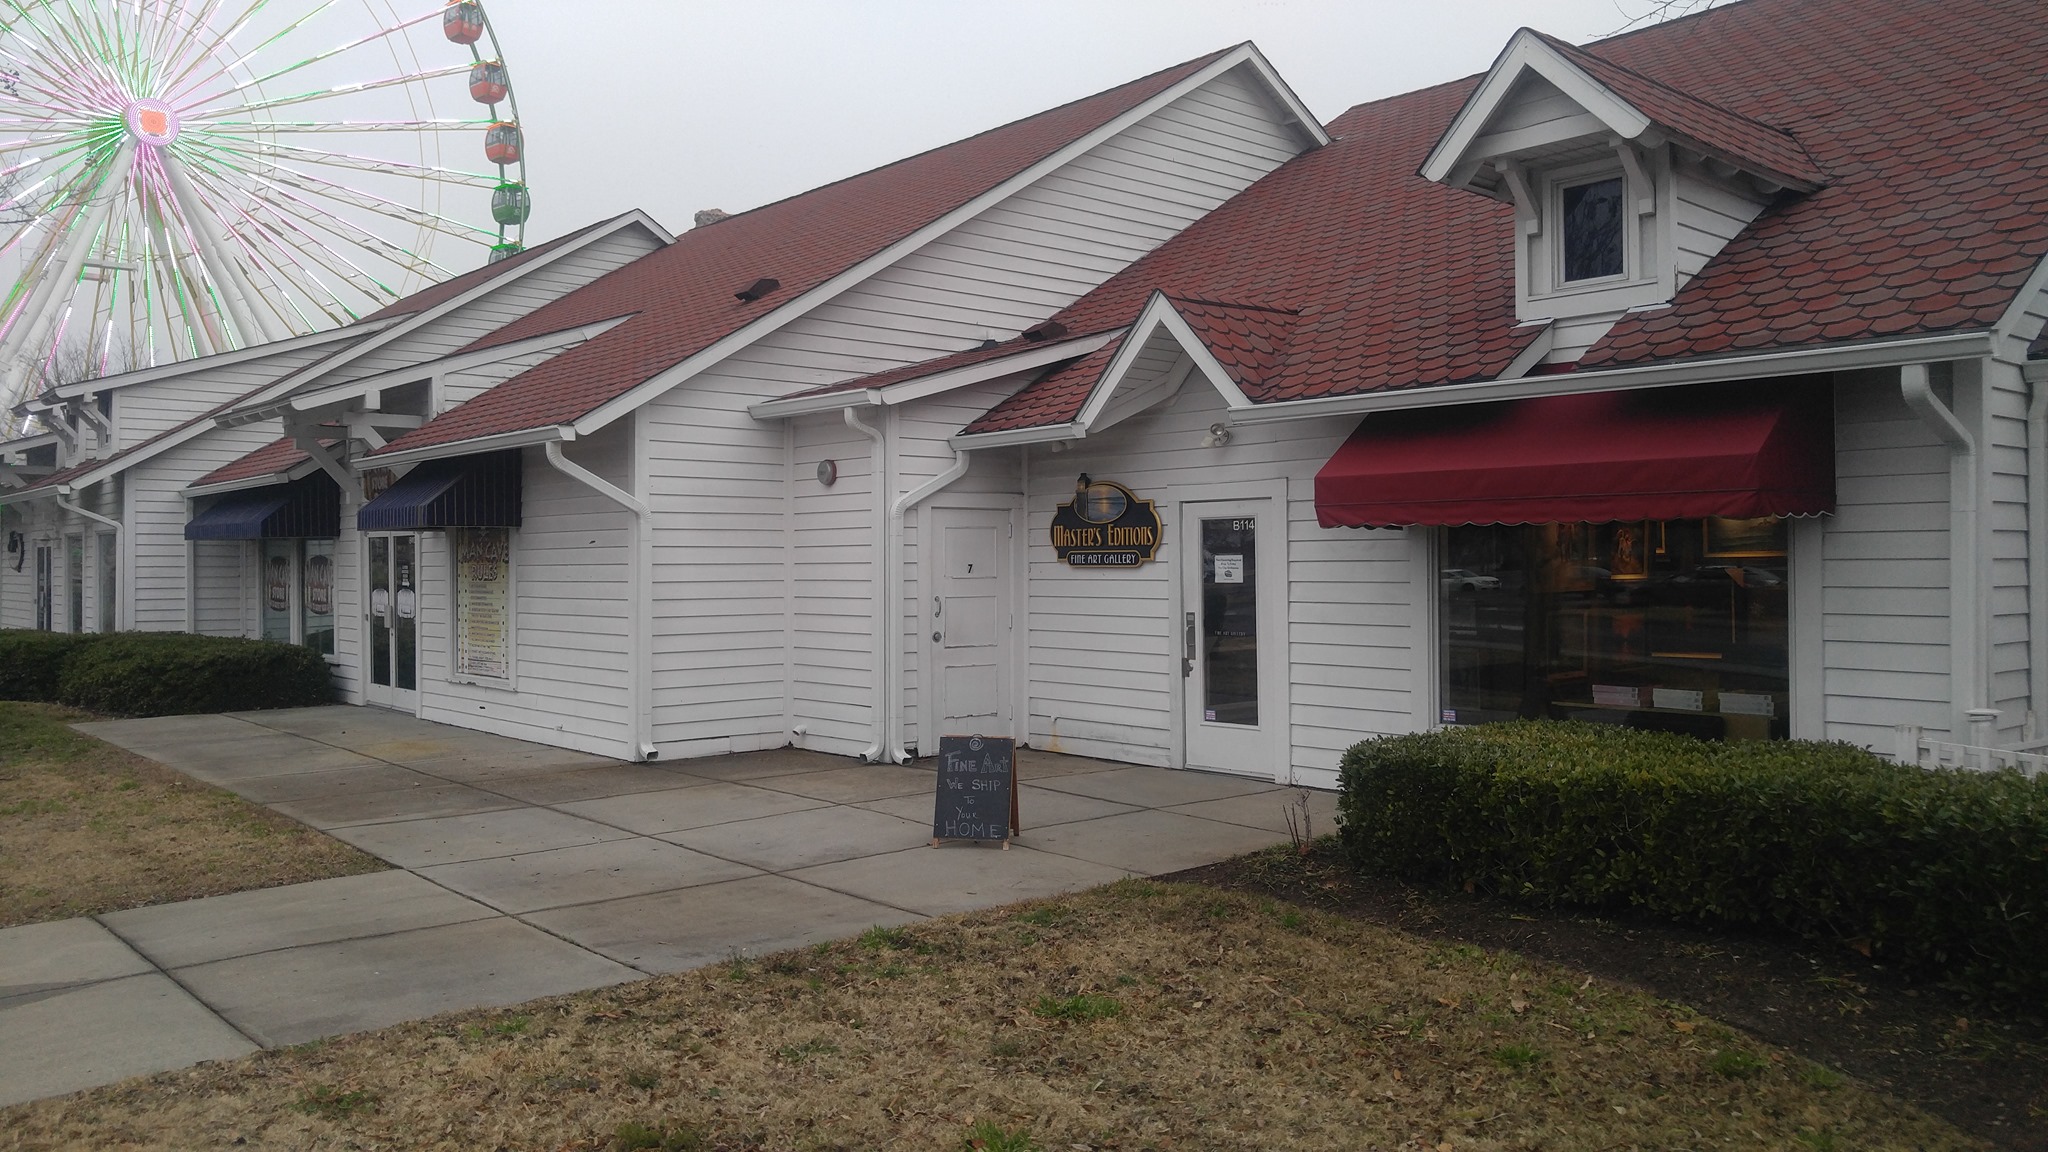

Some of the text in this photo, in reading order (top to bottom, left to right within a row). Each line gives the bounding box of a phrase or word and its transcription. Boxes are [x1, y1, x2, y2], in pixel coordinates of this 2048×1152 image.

[1233, 520, 1255, 531] B114
[1053, 524, 1154, 547] MASTER'S EDITIONS
[461, 543, 483, 562] MAN
[1070, 554, 1137, 564] FINE ART GALLERY
[471, 563, 498, 581] RULES
[967, 563, 974, 574] 7
[971, 779, 1001, 791] SHIP
[944, 820, 1002, 838] HOME
